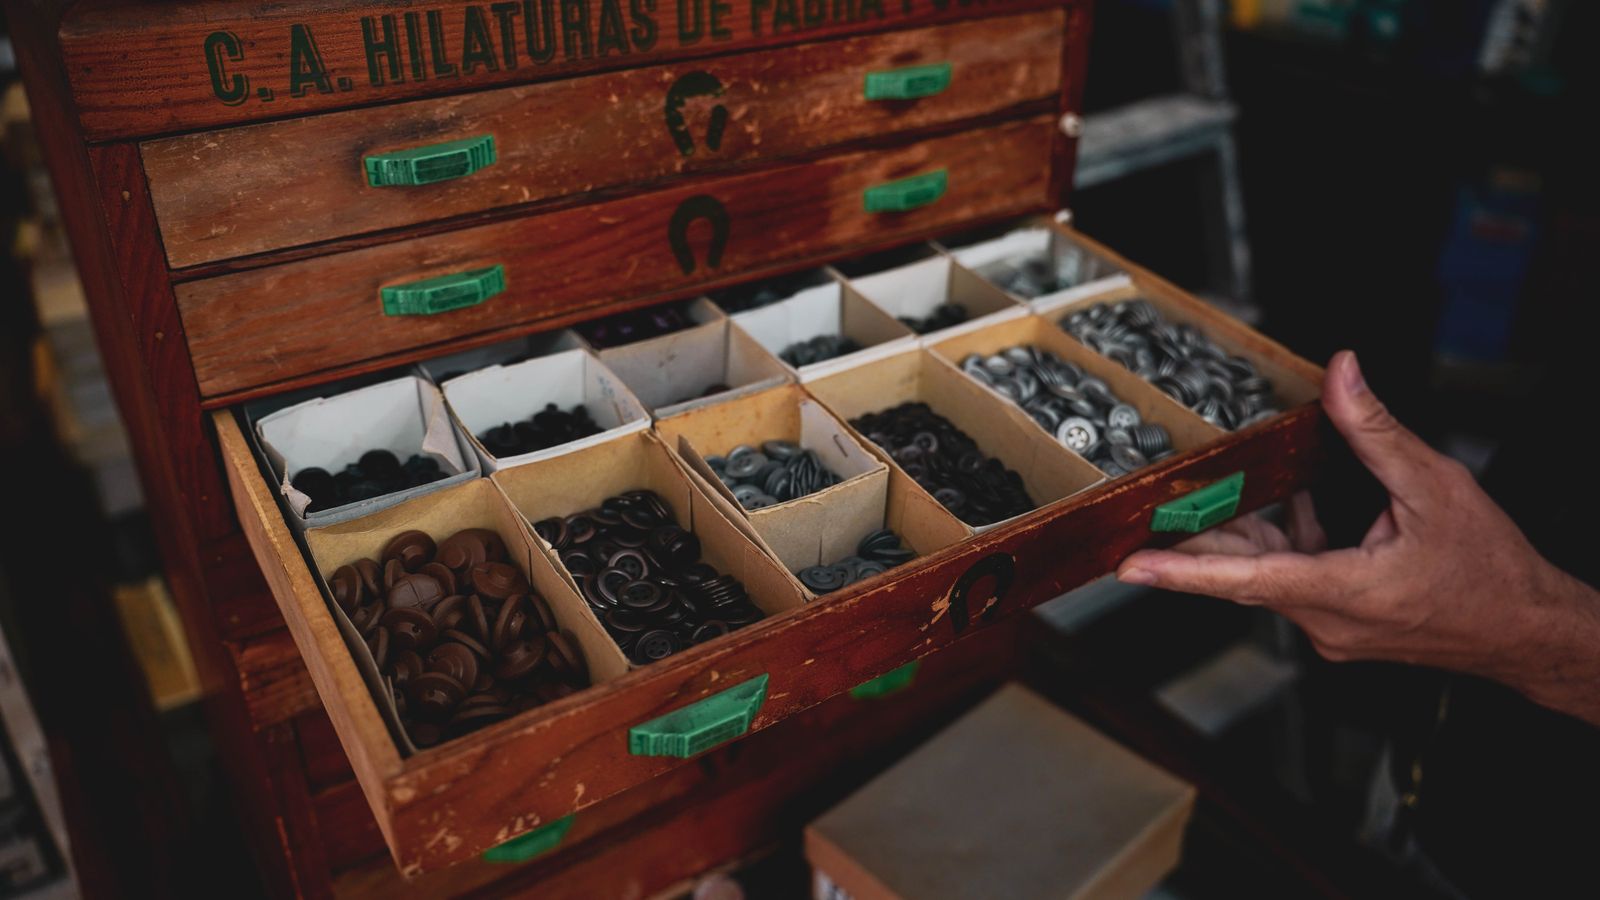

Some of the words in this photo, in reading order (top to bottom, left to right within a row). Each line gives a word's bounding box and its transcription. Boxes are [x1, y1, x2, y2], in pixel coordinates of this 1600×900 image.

[204, 31, 274, 107] C.
[290, 23, 353, 98] A.
[361, 0, 659, 86] HILATURAS
[677, 0, 732, 46] DE
